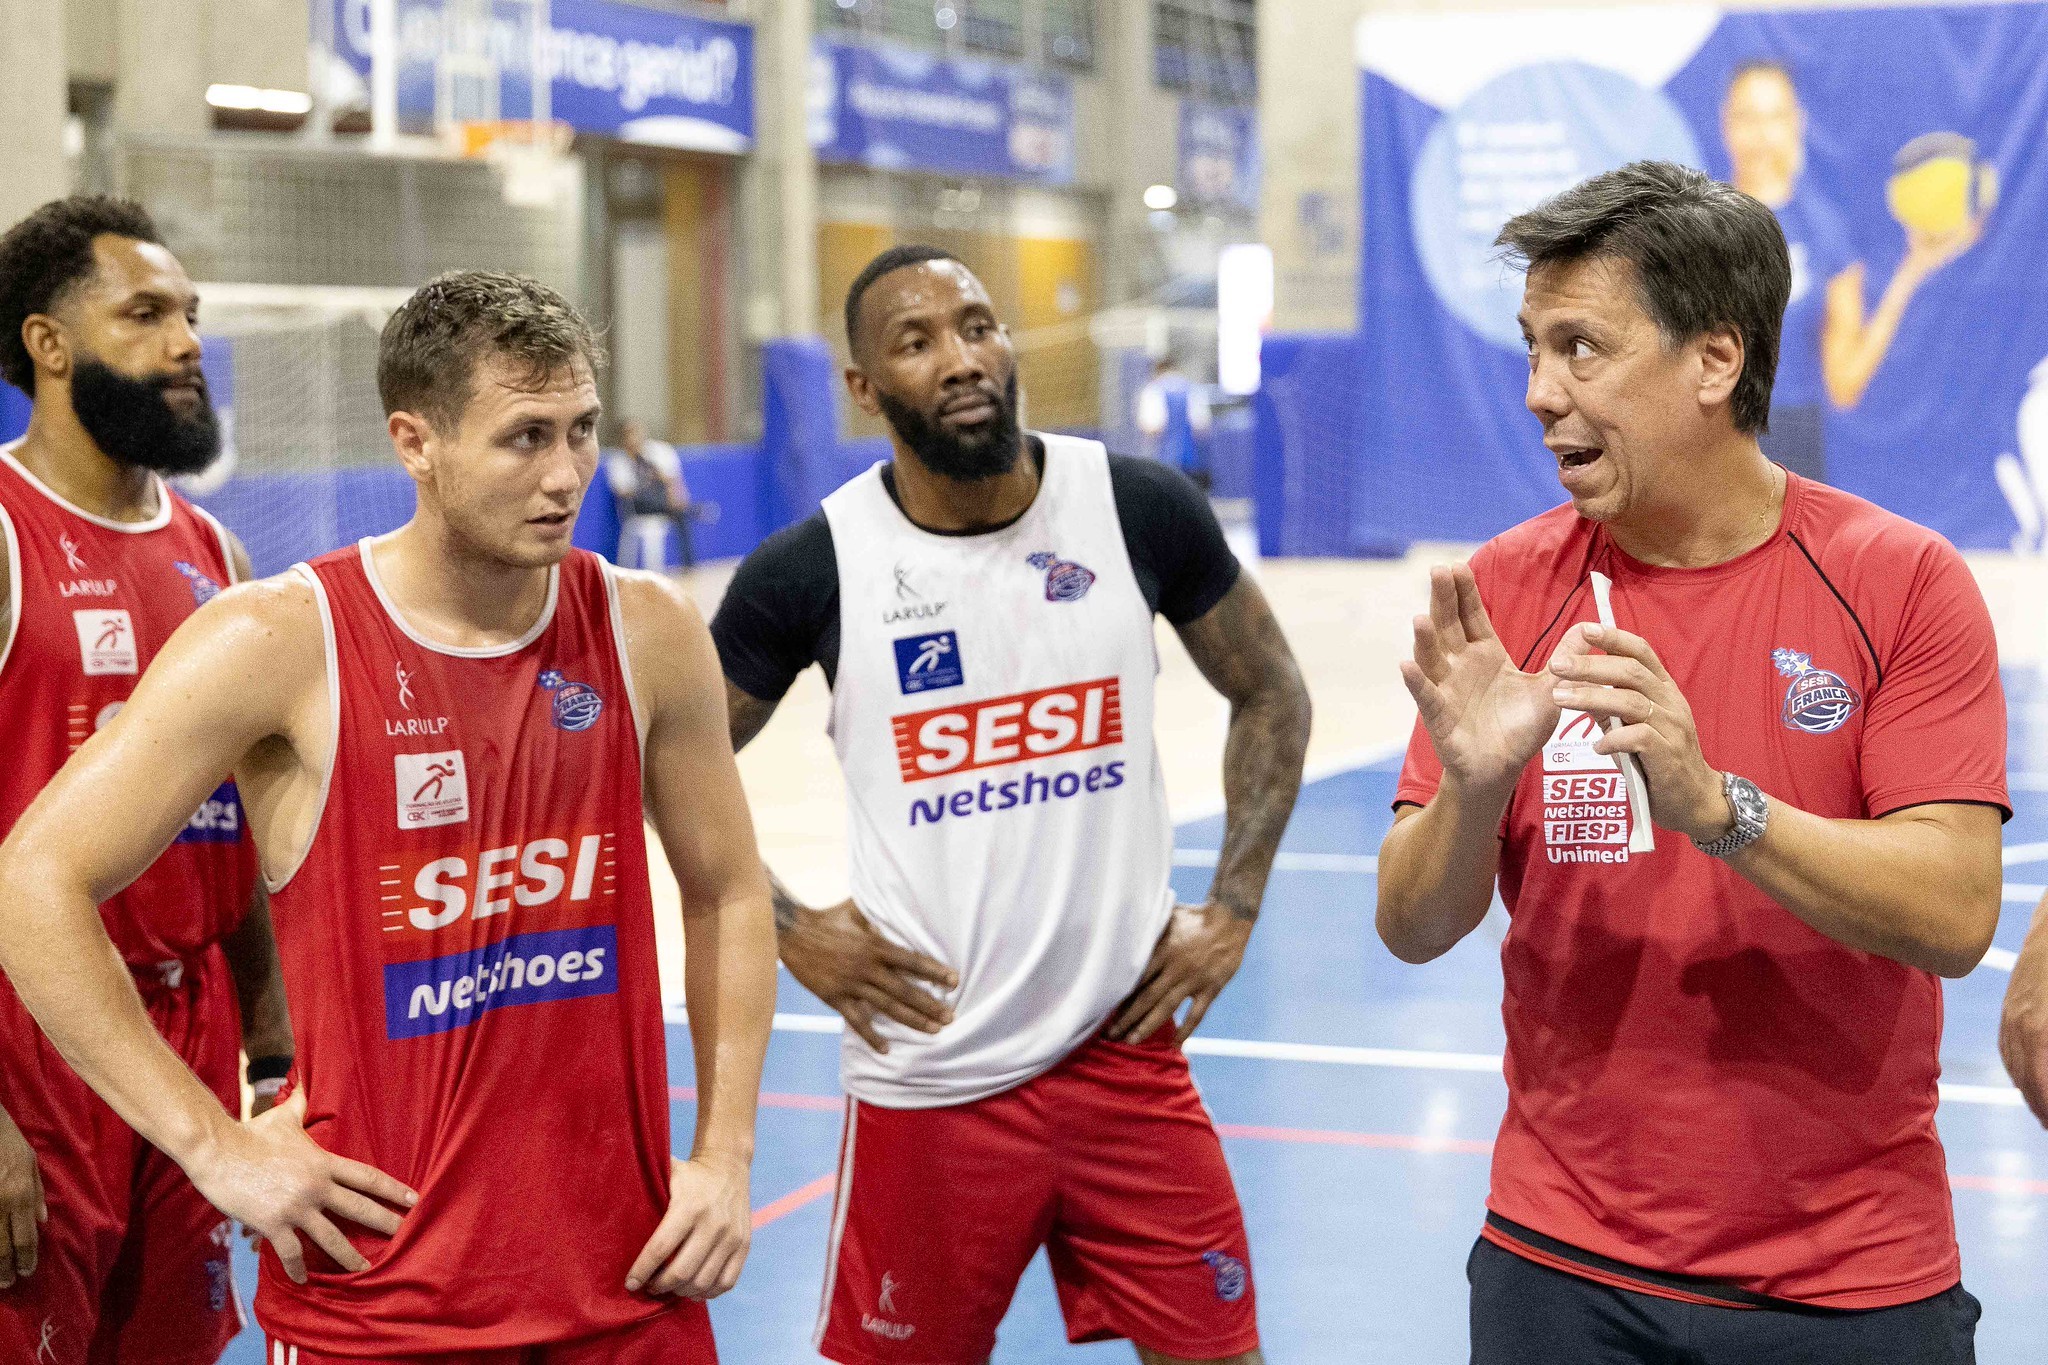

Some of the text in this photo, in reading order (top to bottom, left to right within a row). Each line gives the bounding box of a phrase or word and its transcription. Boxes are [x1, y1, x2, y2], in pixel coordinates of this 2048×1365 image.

[58, 579, 117, 598] LARULP
[1800, 677, 1829, 691] SESI
[1792, 688, 1852, 714] FRANCA
[386, 717, 449, 736] LARULP
[915, 687, 1104, 773] SESI
[1552, 752, 1571, 763] CBC
[1550, 777, 1618, 800] SESI
[1552, 823, 1620, 840] FIESP
[1547, 846, 1629, 864] Unimed
[408, 834, 601, 931] SESI
